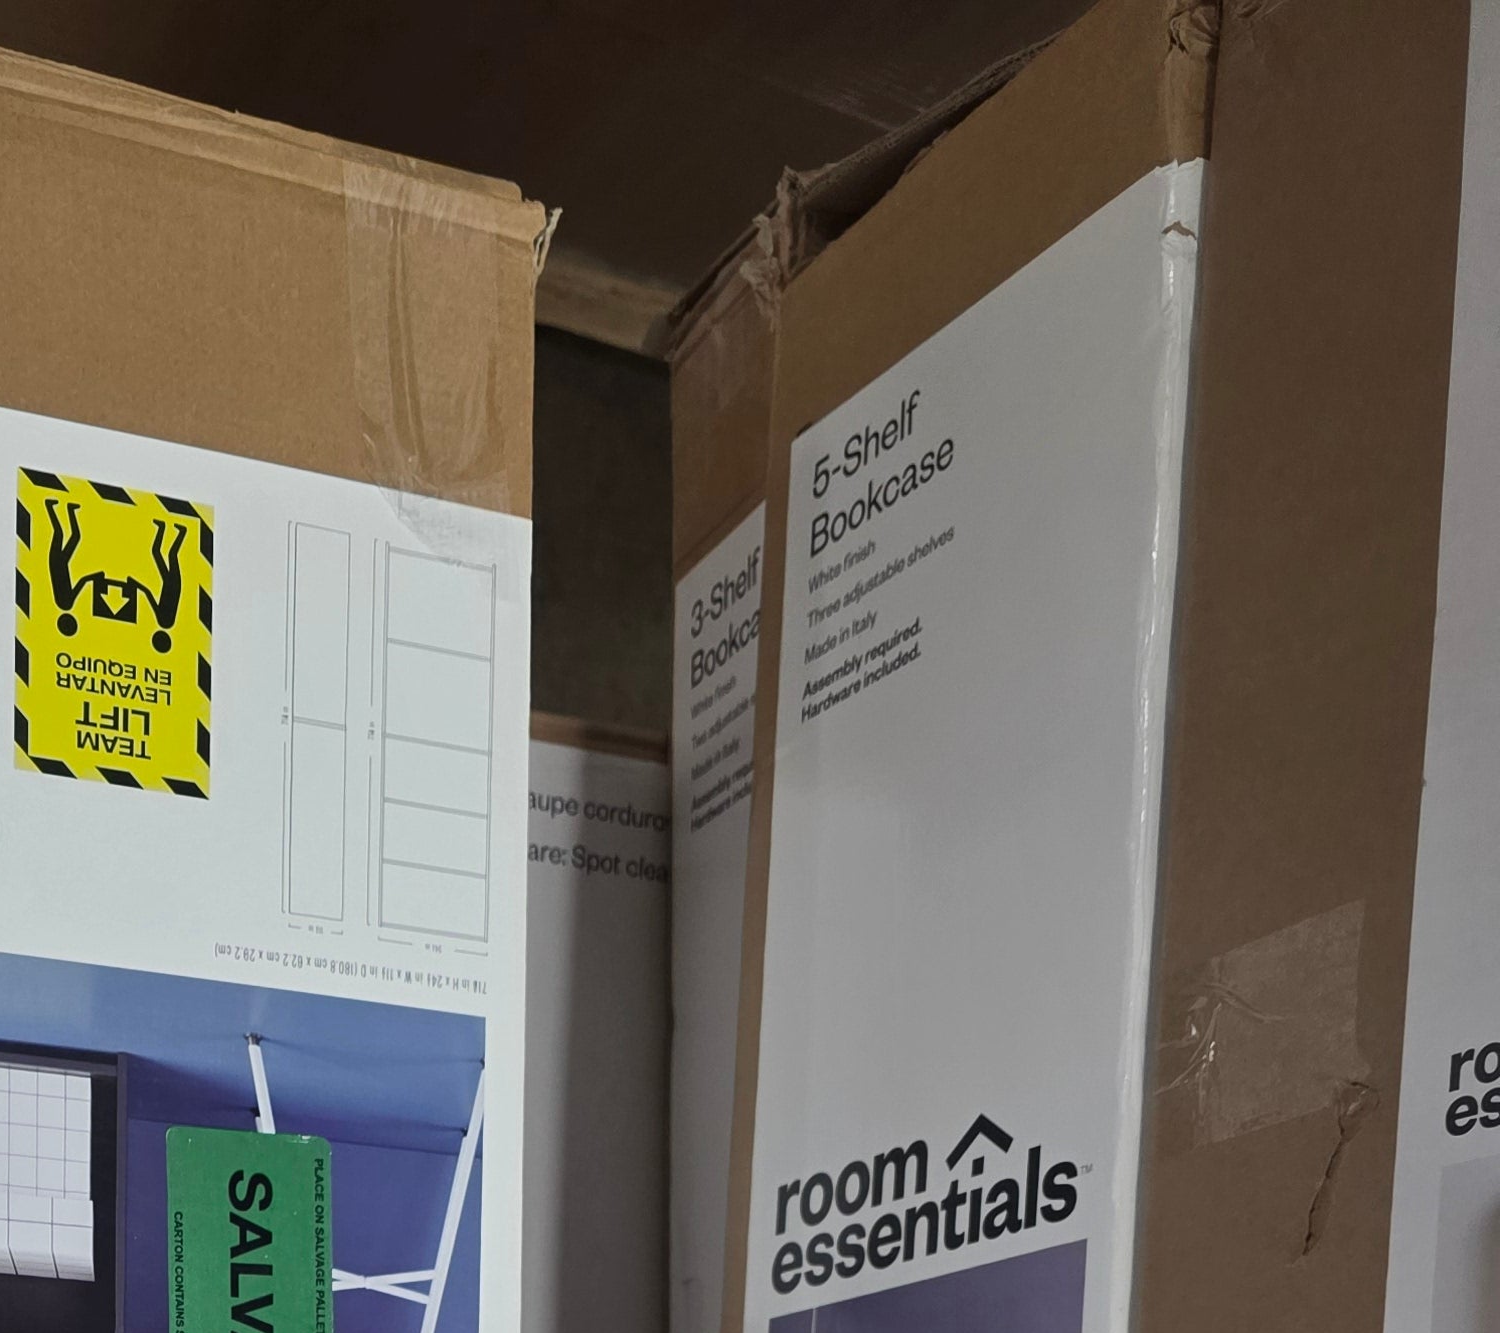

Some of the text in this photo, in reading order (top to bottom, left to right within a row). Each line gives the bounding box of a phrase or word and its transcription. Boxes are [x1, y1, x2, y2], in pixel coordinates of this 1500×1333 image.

[811, 388, 921, 500] 5-Shelf
[808, 437, 955, 559] Bookcase
[690, 544, 761, 639] 3-Shelf
[805, 525, 956, 630] Three adjustable shelves
[806, 538, 877, 596] White finish
[800, 615, 923, 701] Assembly required.
[802, 609, 879, 665] Made in Italy
[55, 652, 172, 686] EN EQUIPO
[56, 671, 171, 706] LEVANTAR
[800, 641, 922, 724] Hardware included.
[75, 701, 150, 736] LIFT
[76, 730, 151, 760] TEAM
[569, 842, 623, 881] Spot
[264, 949, 281, 966] cm
[311, 955, 328, 973] cm
[1447, 1041, 1500, 1093] ro
[314, 1158, 325, 1202] PLACE
[774, 1138, 929, 1237] room
[173, 1211, 184, 1263] CARTON
[314, 1204, 325, 1224] ON
[770, 1144, 1079, 1296] essentials
[314, 1227, 325, 1286] SALVAGE
[174, 1265, 185, 1327] CONTAINS
